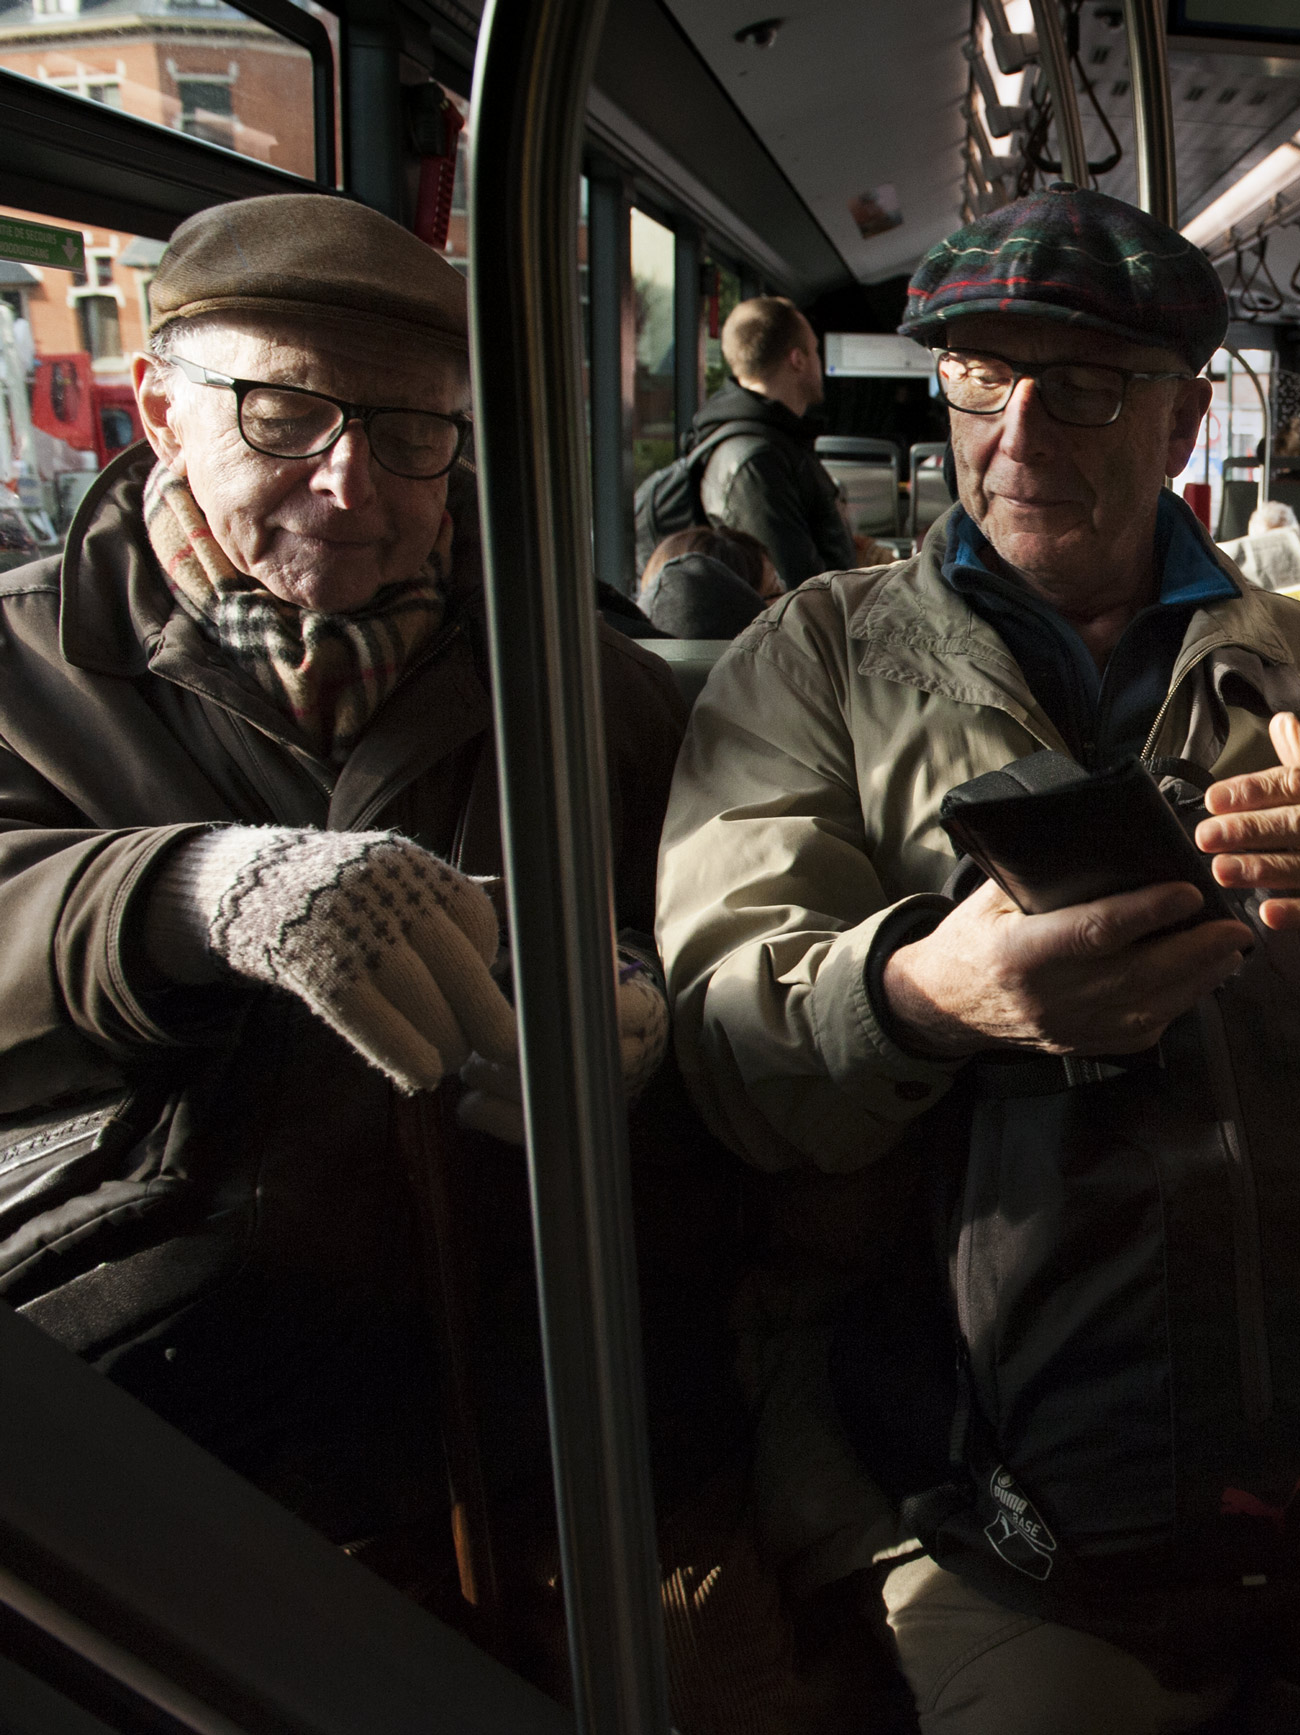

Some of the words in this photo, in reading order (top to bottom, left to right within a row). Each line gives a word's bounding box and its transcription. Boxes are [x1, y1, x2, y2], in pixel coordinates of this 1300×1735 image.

[14, 226, 24, 239] DE
[26, 229, 57, 244] SECOURS
[993, 1485, 1028, 1514] PUMA
